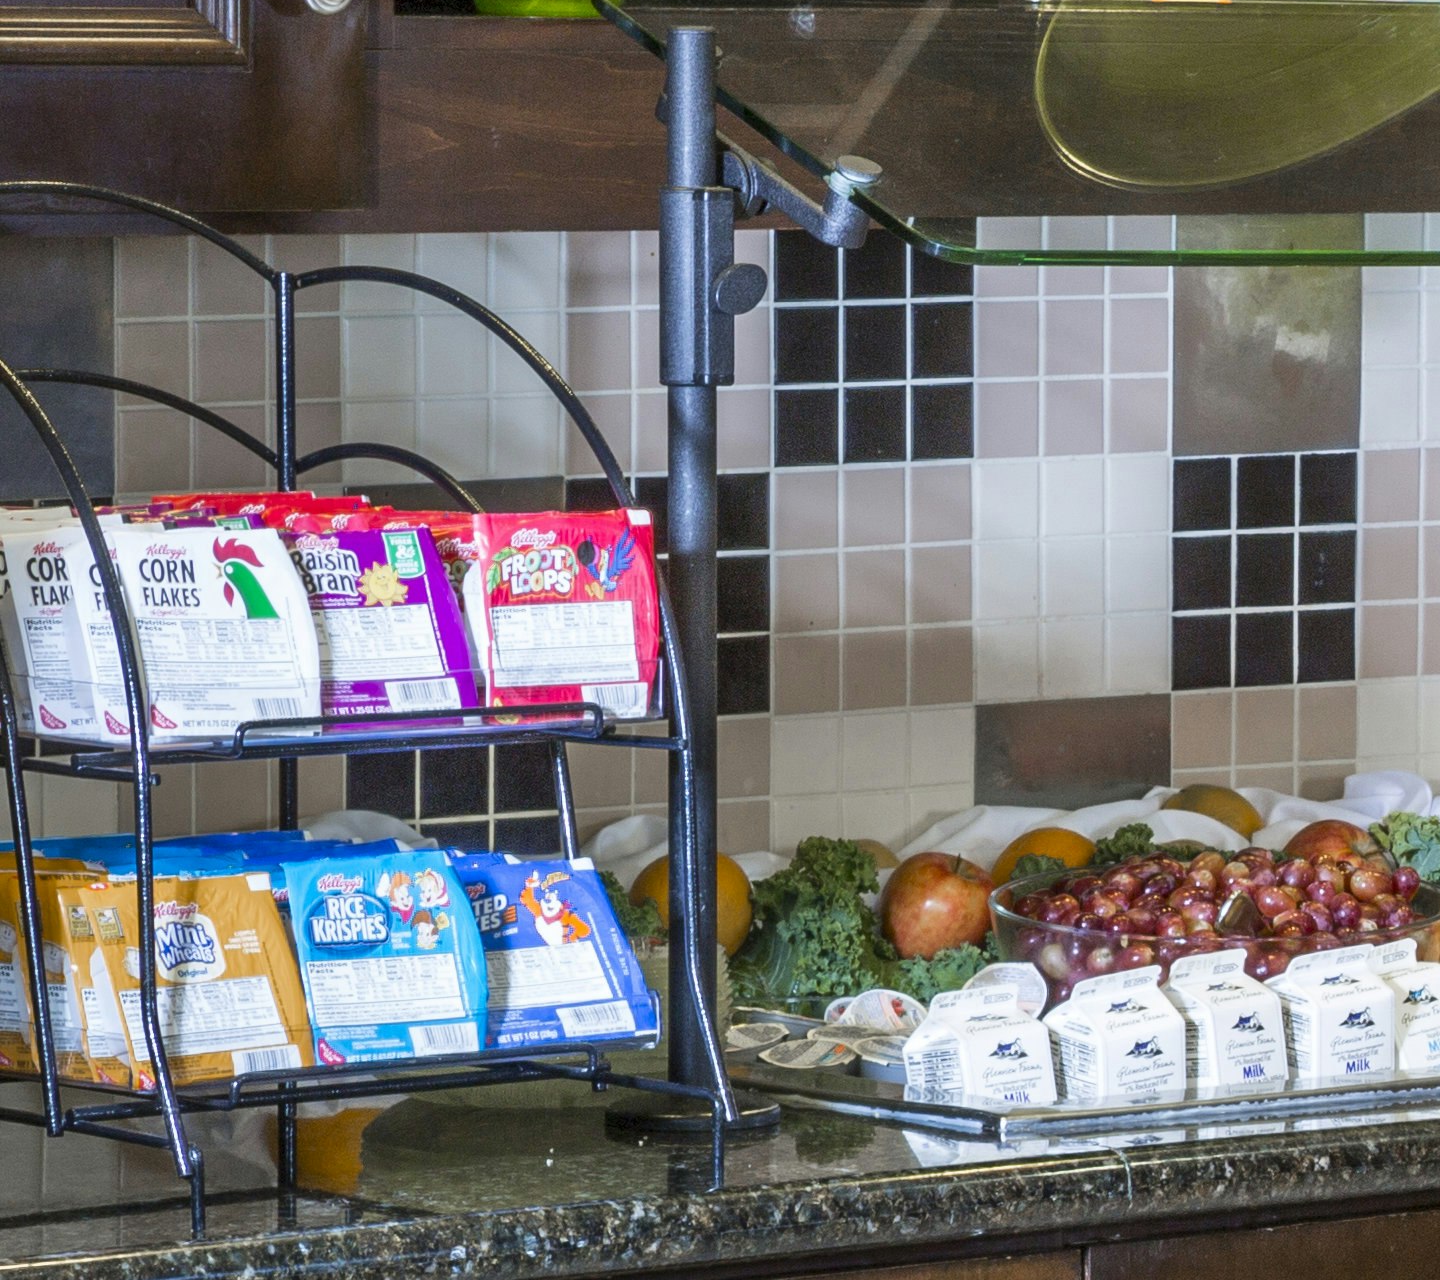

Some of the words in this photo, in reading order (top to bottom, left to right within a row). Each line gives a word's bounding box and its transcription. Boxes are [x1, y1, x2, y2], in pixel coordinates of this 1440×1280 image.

[146, 543, 187, 559] Kellogg's
[290, 548, 358, 573] Raisin
[26, 556, 68, 583] COR
[139, 558, 196, 584] CORN
[500, 548, 566, 582] FROOT
[301, 573, 358, 595] Bran
[511, 569, 572, 596] LOOPS
[31, 584, 73, 607] FLAK
[142, 587, 201, 608] FLAKES
[318, 873, 364, 893] Kellogg's
[325, 896, 366, 920] RICE
[310, 915, 388, 944] KRISPIES
[160, 945, 215, 971] Wheats
[177, 967, 208, 979] Original
[497, 1033, 513, 1044] NET
[512, 1032, 524, 1042] WT
[528, 1031, 539, 1040] OZ
[1242, 1063, 1266, 1080] Milk
[1345, 1058, 1371, 1075] Milk
